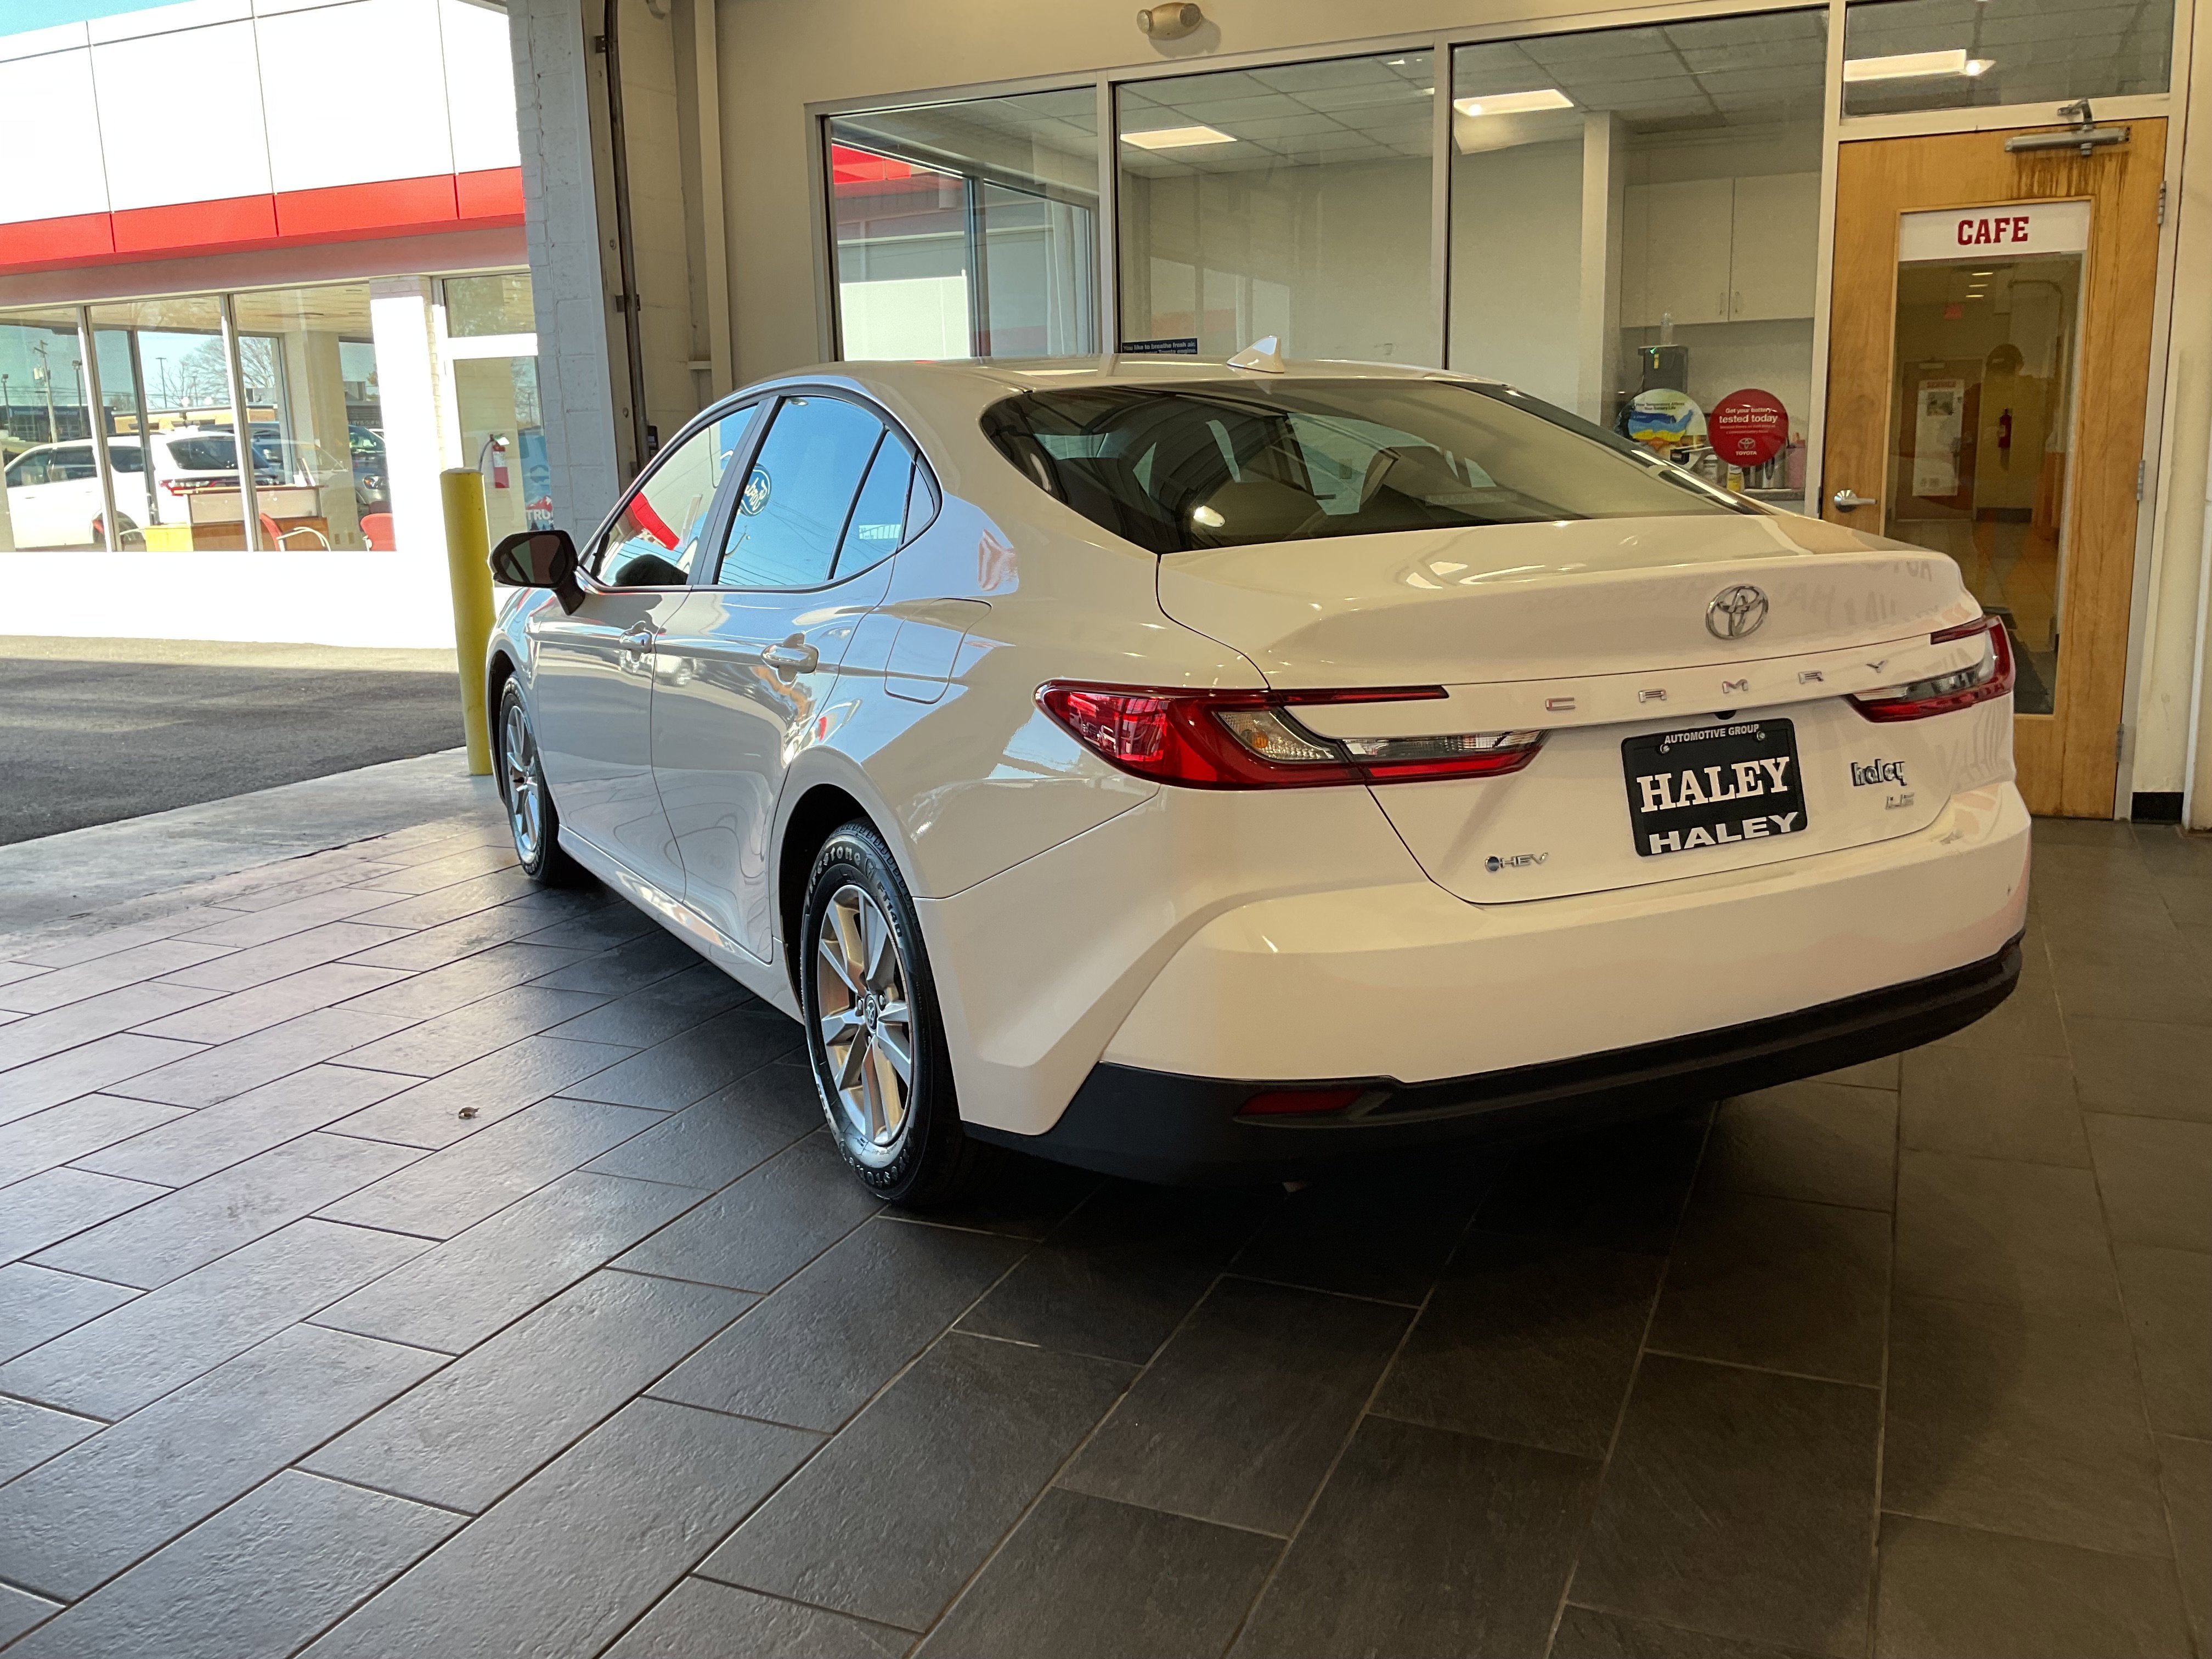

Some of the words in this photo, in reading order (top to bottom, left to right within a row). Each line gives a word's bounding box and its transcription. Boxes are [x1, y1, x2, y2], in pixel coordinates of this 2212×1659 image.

[1957, 216, 2029, 245] CAFE
[1719, 415, 1748, 423] tested
[1751, 414, 1778, 424] today
[1545, 660, 1888, 711] CAMRY
[1664, 728, 1726, 744] AUTOMOTIVE
[1728, 724, 1759, 736] GROUP
[1636, 757, 1790, 812] HALEY
[1649, 812, 1798, 854] HALEY
